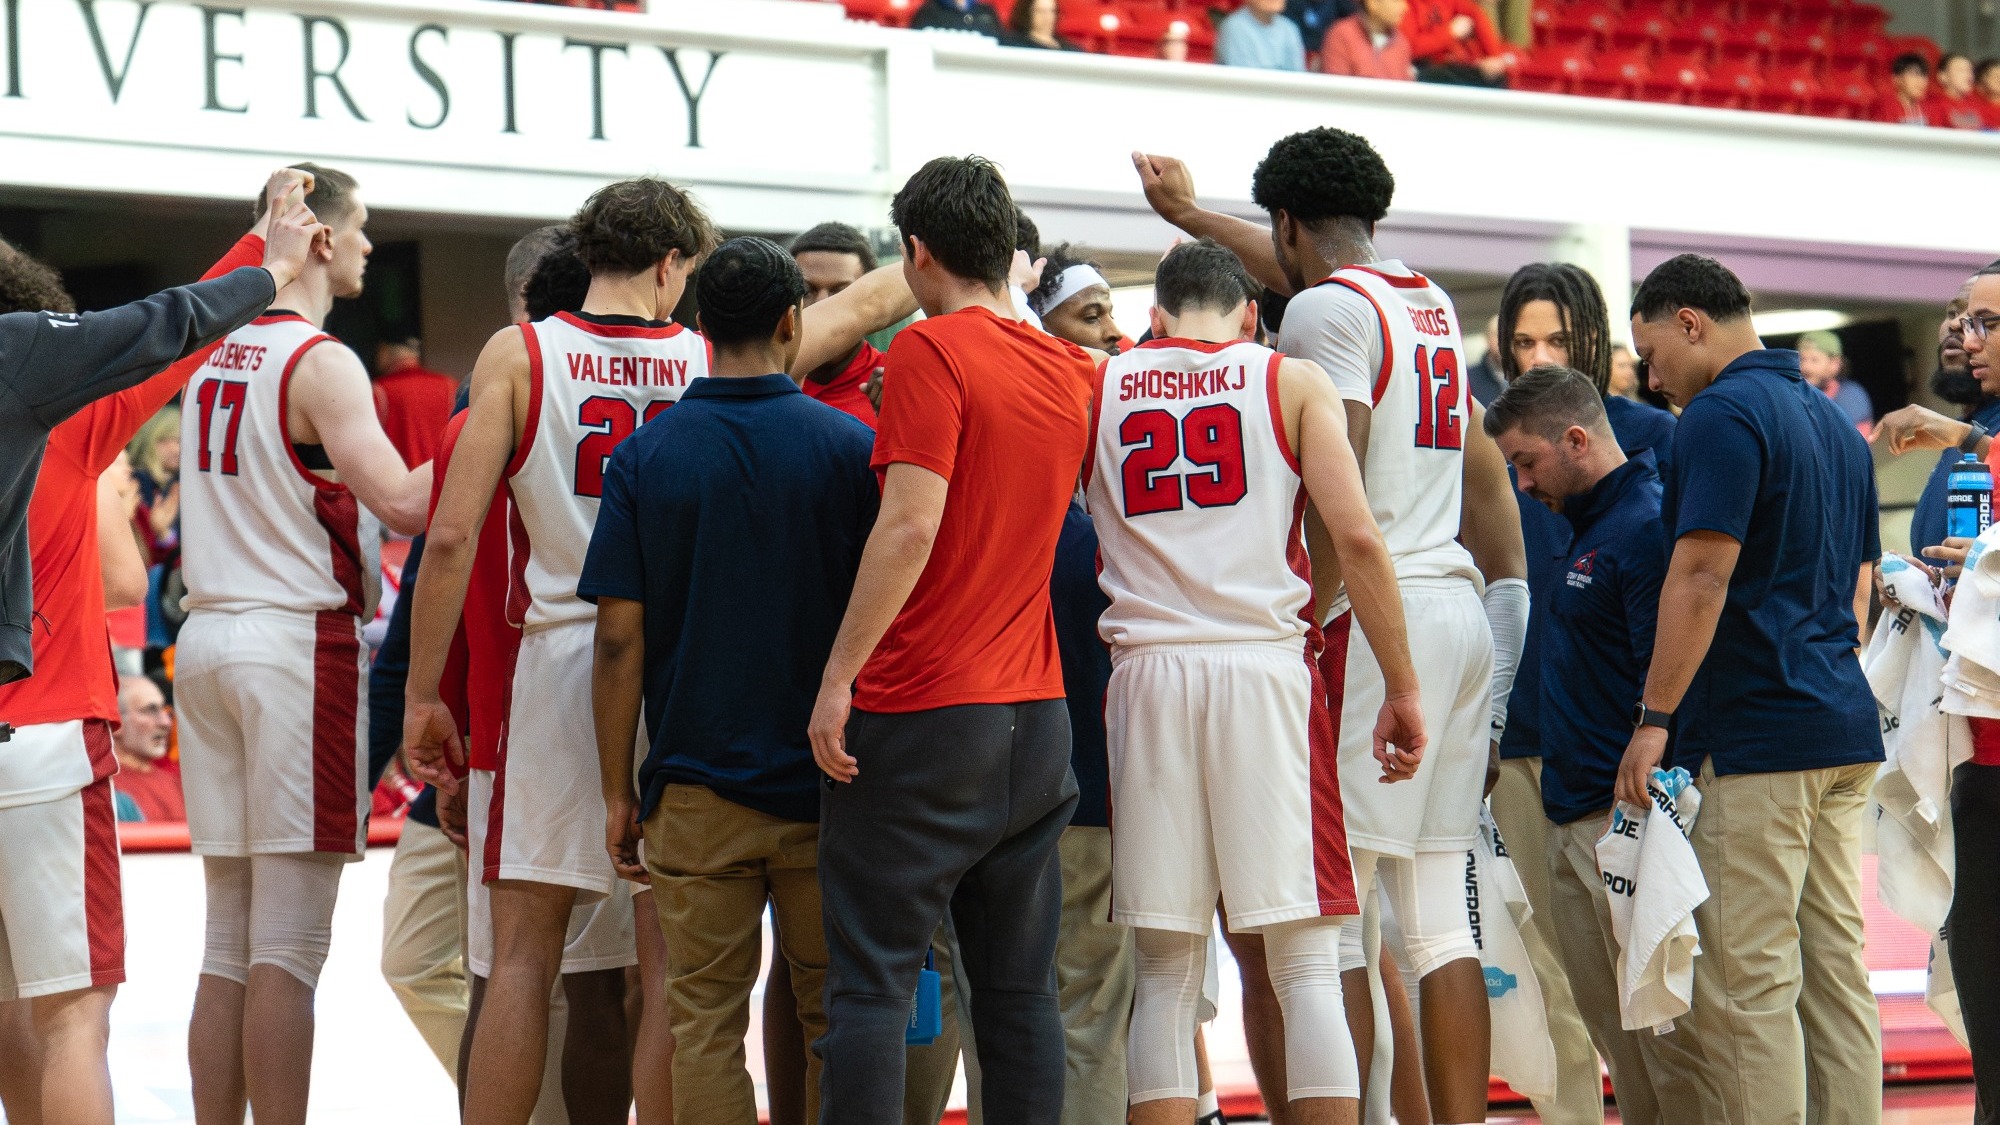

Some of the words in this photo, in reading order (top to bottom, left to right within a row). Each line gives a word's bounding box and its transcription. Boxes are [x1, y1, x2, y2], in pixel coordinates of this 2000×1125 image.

[2, 0, 728, 148] IVERSITY
[566, 352, 688, 387] VALENTINY
[1406, 306, 1450, 336] GOODS
[196, 377, 249, 476] 17
[1119, 365, 1246, 401] SHOSHKIKJ
[1414, 343, 1462, 452] 12
[574, 395, 678, 498] 2
[1119, 402, 1248, 519] 29
